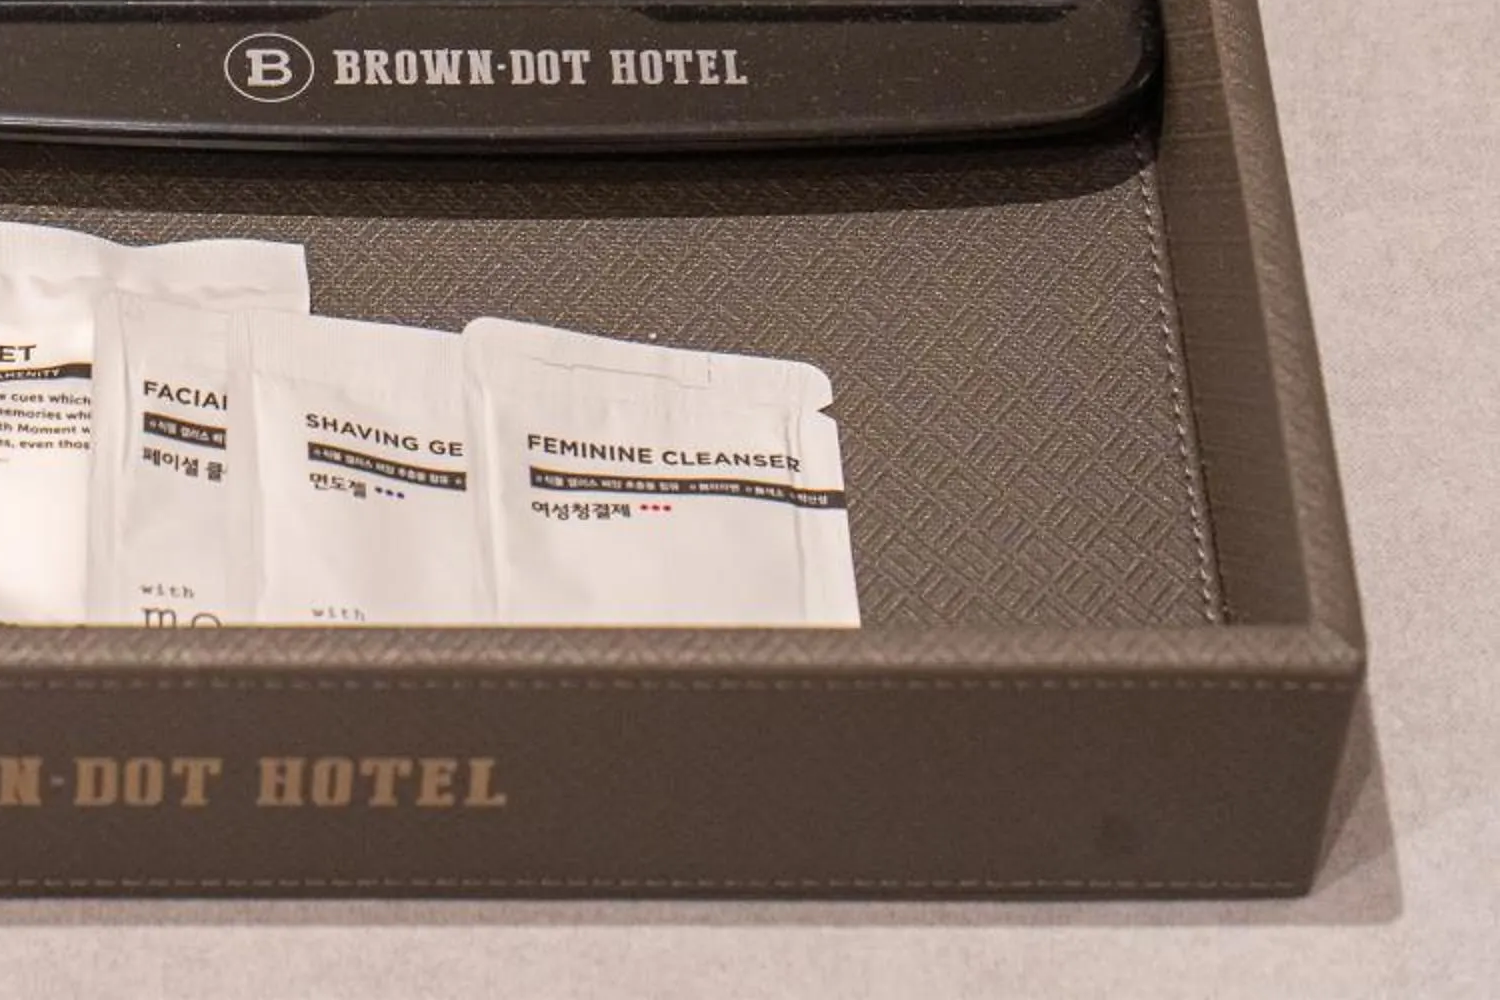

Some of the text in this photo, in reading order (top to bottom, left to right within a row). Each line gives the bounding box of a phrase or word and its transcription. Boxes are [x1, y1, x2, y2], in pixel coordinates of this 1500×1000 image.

[609, 48, 749, 86] HOTEL
[305, 413, 464, 457] SHAVING GE
[527, 433, 801, 472] FEMININE CLEANSER
[141, 583, 195, 599] with
[255, 756, 508, 807] HOTEL
